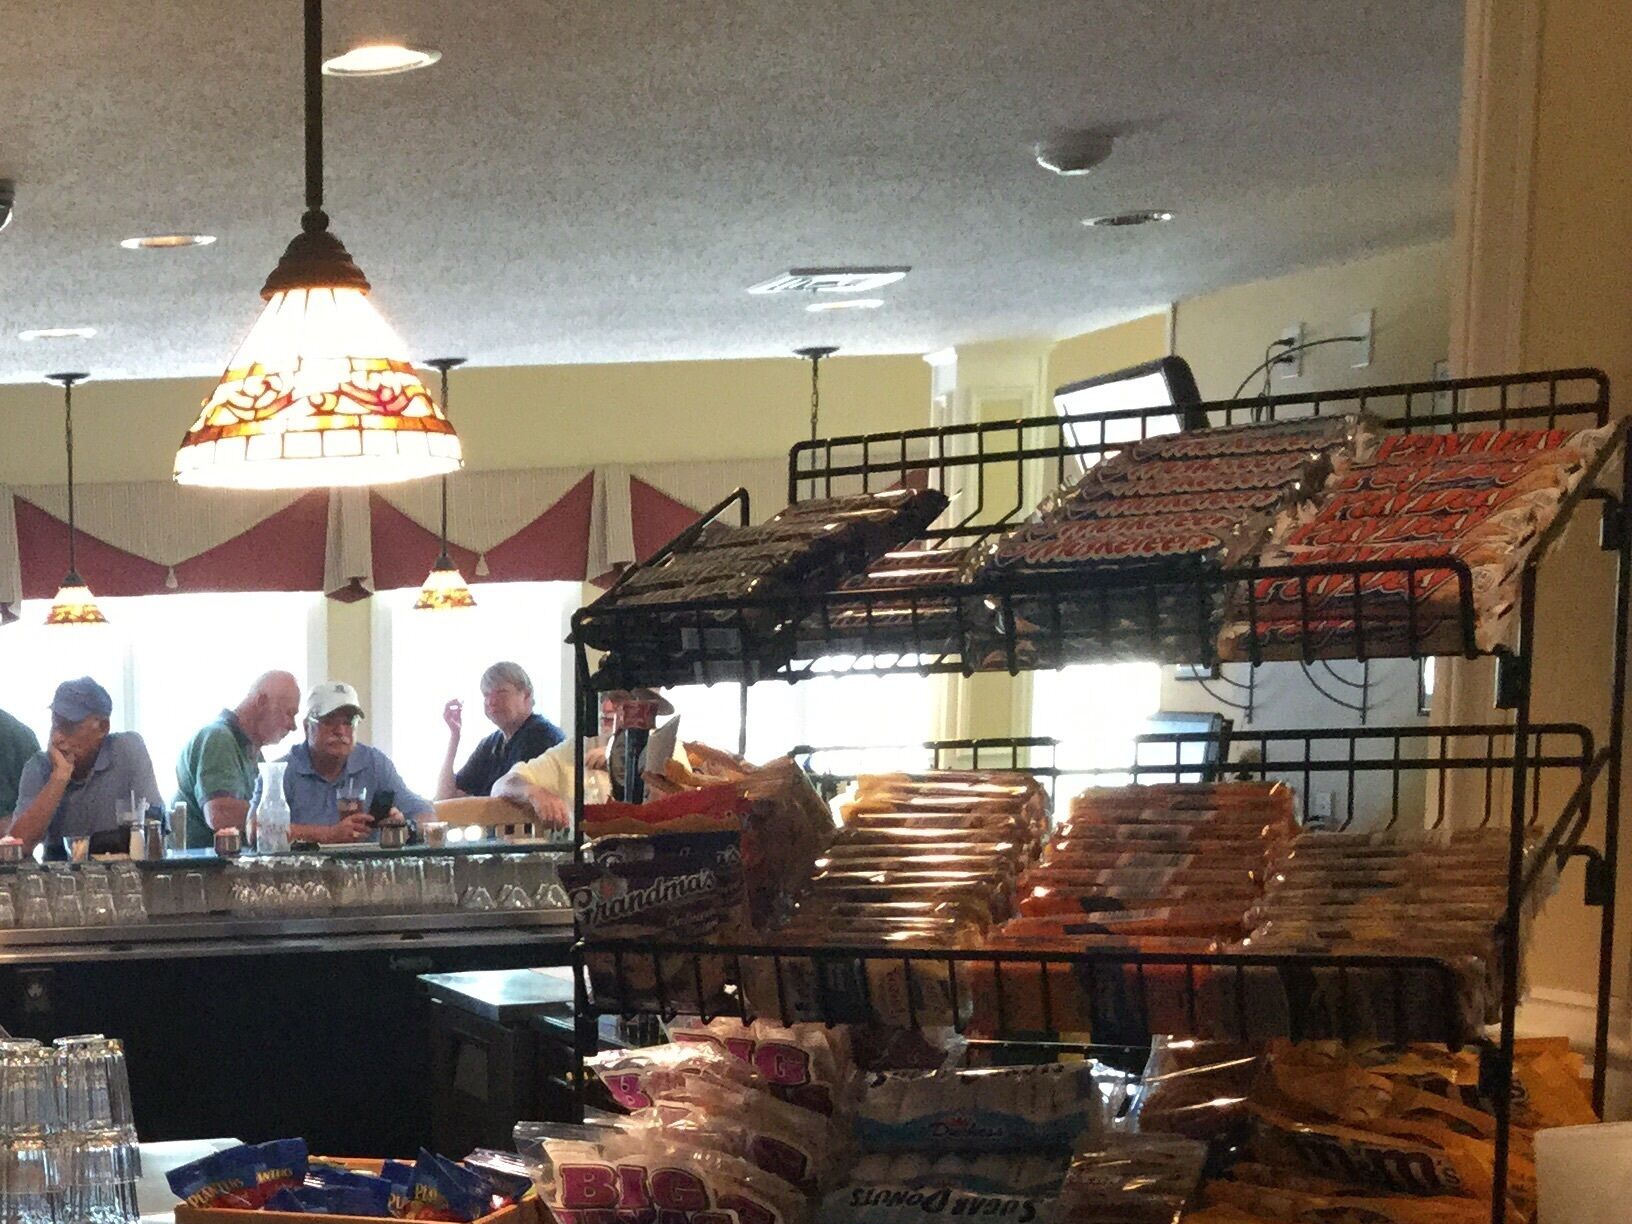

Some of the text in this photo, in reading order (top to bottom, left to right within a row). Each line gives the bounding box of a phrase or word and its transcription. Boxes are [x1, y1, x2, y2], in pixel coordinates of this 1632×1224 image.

[570, 867, 717, 925] Grandma's
[558, 1163, 710, 1211] BIG
[849, 1186, 1038, 1223] SUGAR DONUTS
